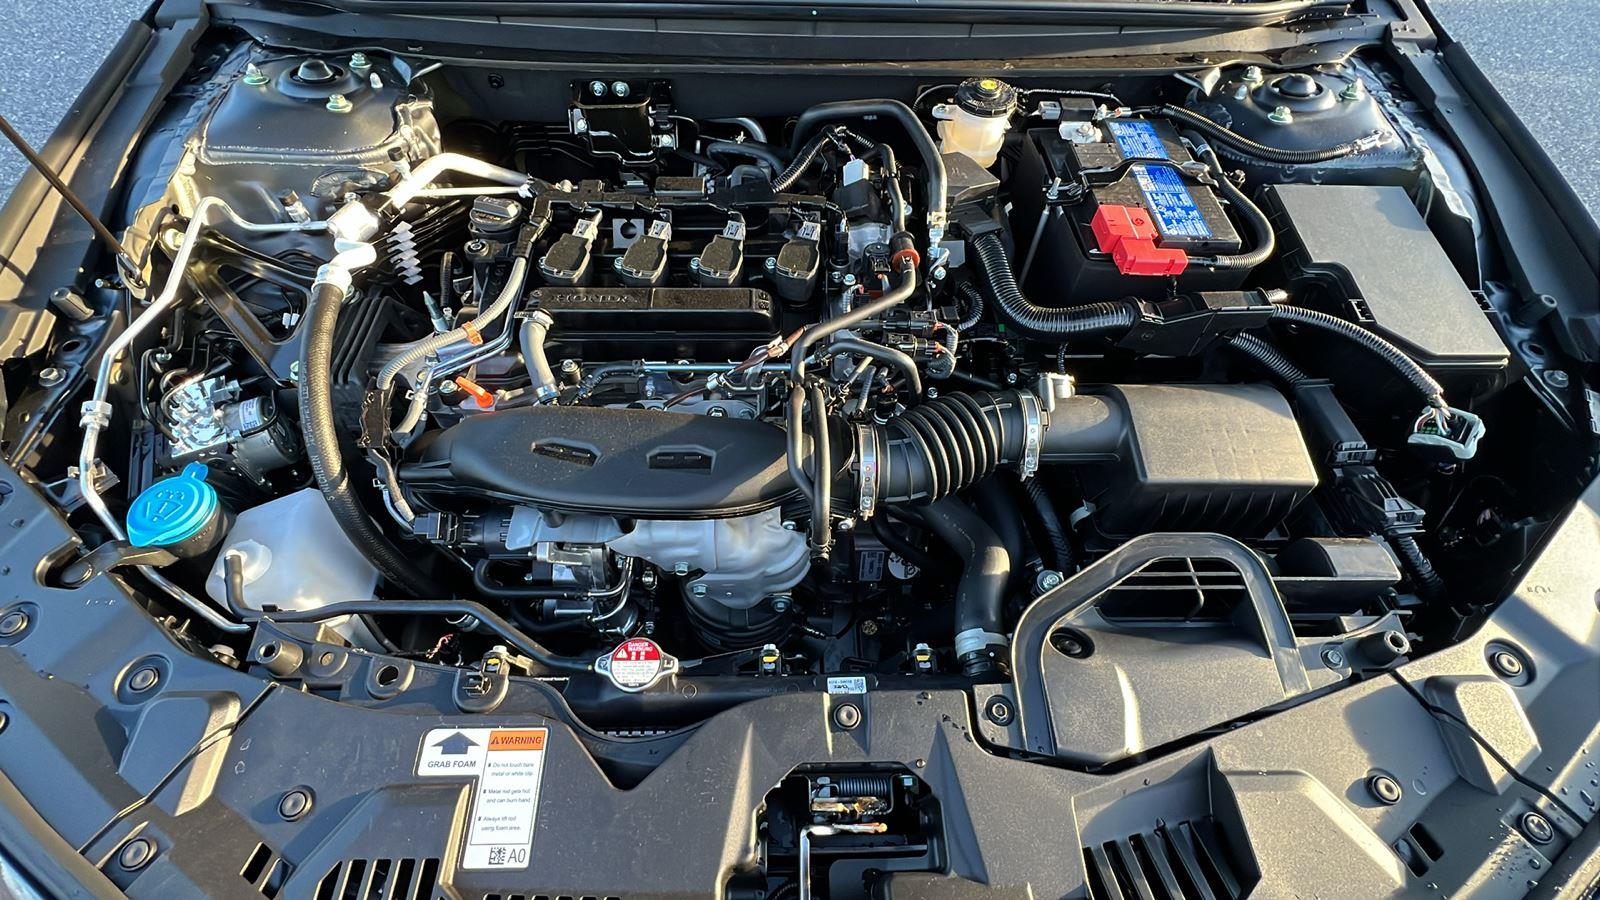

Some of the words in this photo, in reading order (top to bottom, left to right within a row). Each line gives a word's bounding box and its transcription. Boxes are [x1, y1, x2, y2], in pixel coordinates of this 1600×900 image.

[551, 294, 638, 303] HONDA
[310, 455, 331, 493] NICHIRIN
[501, 736, 542, 745] WARNING
[427, 760, 451, 768] GRAB
[452, 760, 477, 768] FOAM
